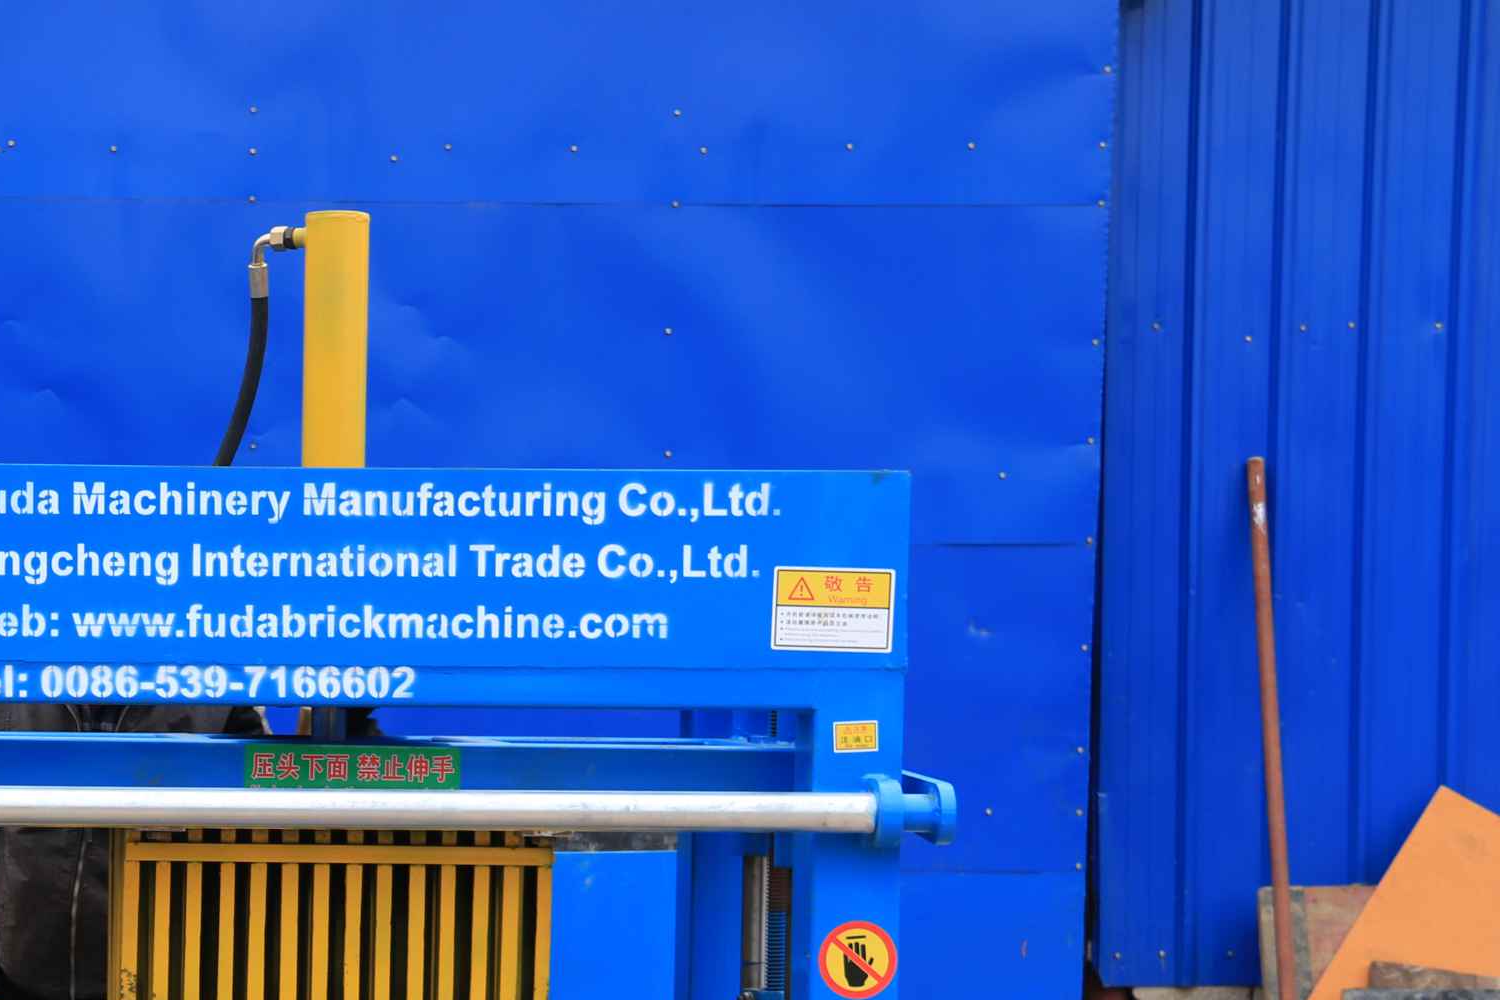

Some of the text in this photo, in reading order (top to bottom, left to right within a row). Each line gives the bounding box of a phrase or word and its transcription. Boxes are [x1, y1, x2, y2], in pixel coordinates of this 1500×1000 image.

[73, 481, 291, 523] Machinery
[303, 482, 606, 525] Manufacturing
[618, 481, 781, 523] Co.,Ltd.
[192, 543, 457, 578] International
[469, 544, 586, 578] Trade
[598, 543, 760, 584] Co.,Ltd.
[72, 603, 669, 639] www.fudabrickmachine.com
[41, 665, 416, 699] 0086-539-7166602
[252, 752, 456, 783] 压头下面 禁止伸手
